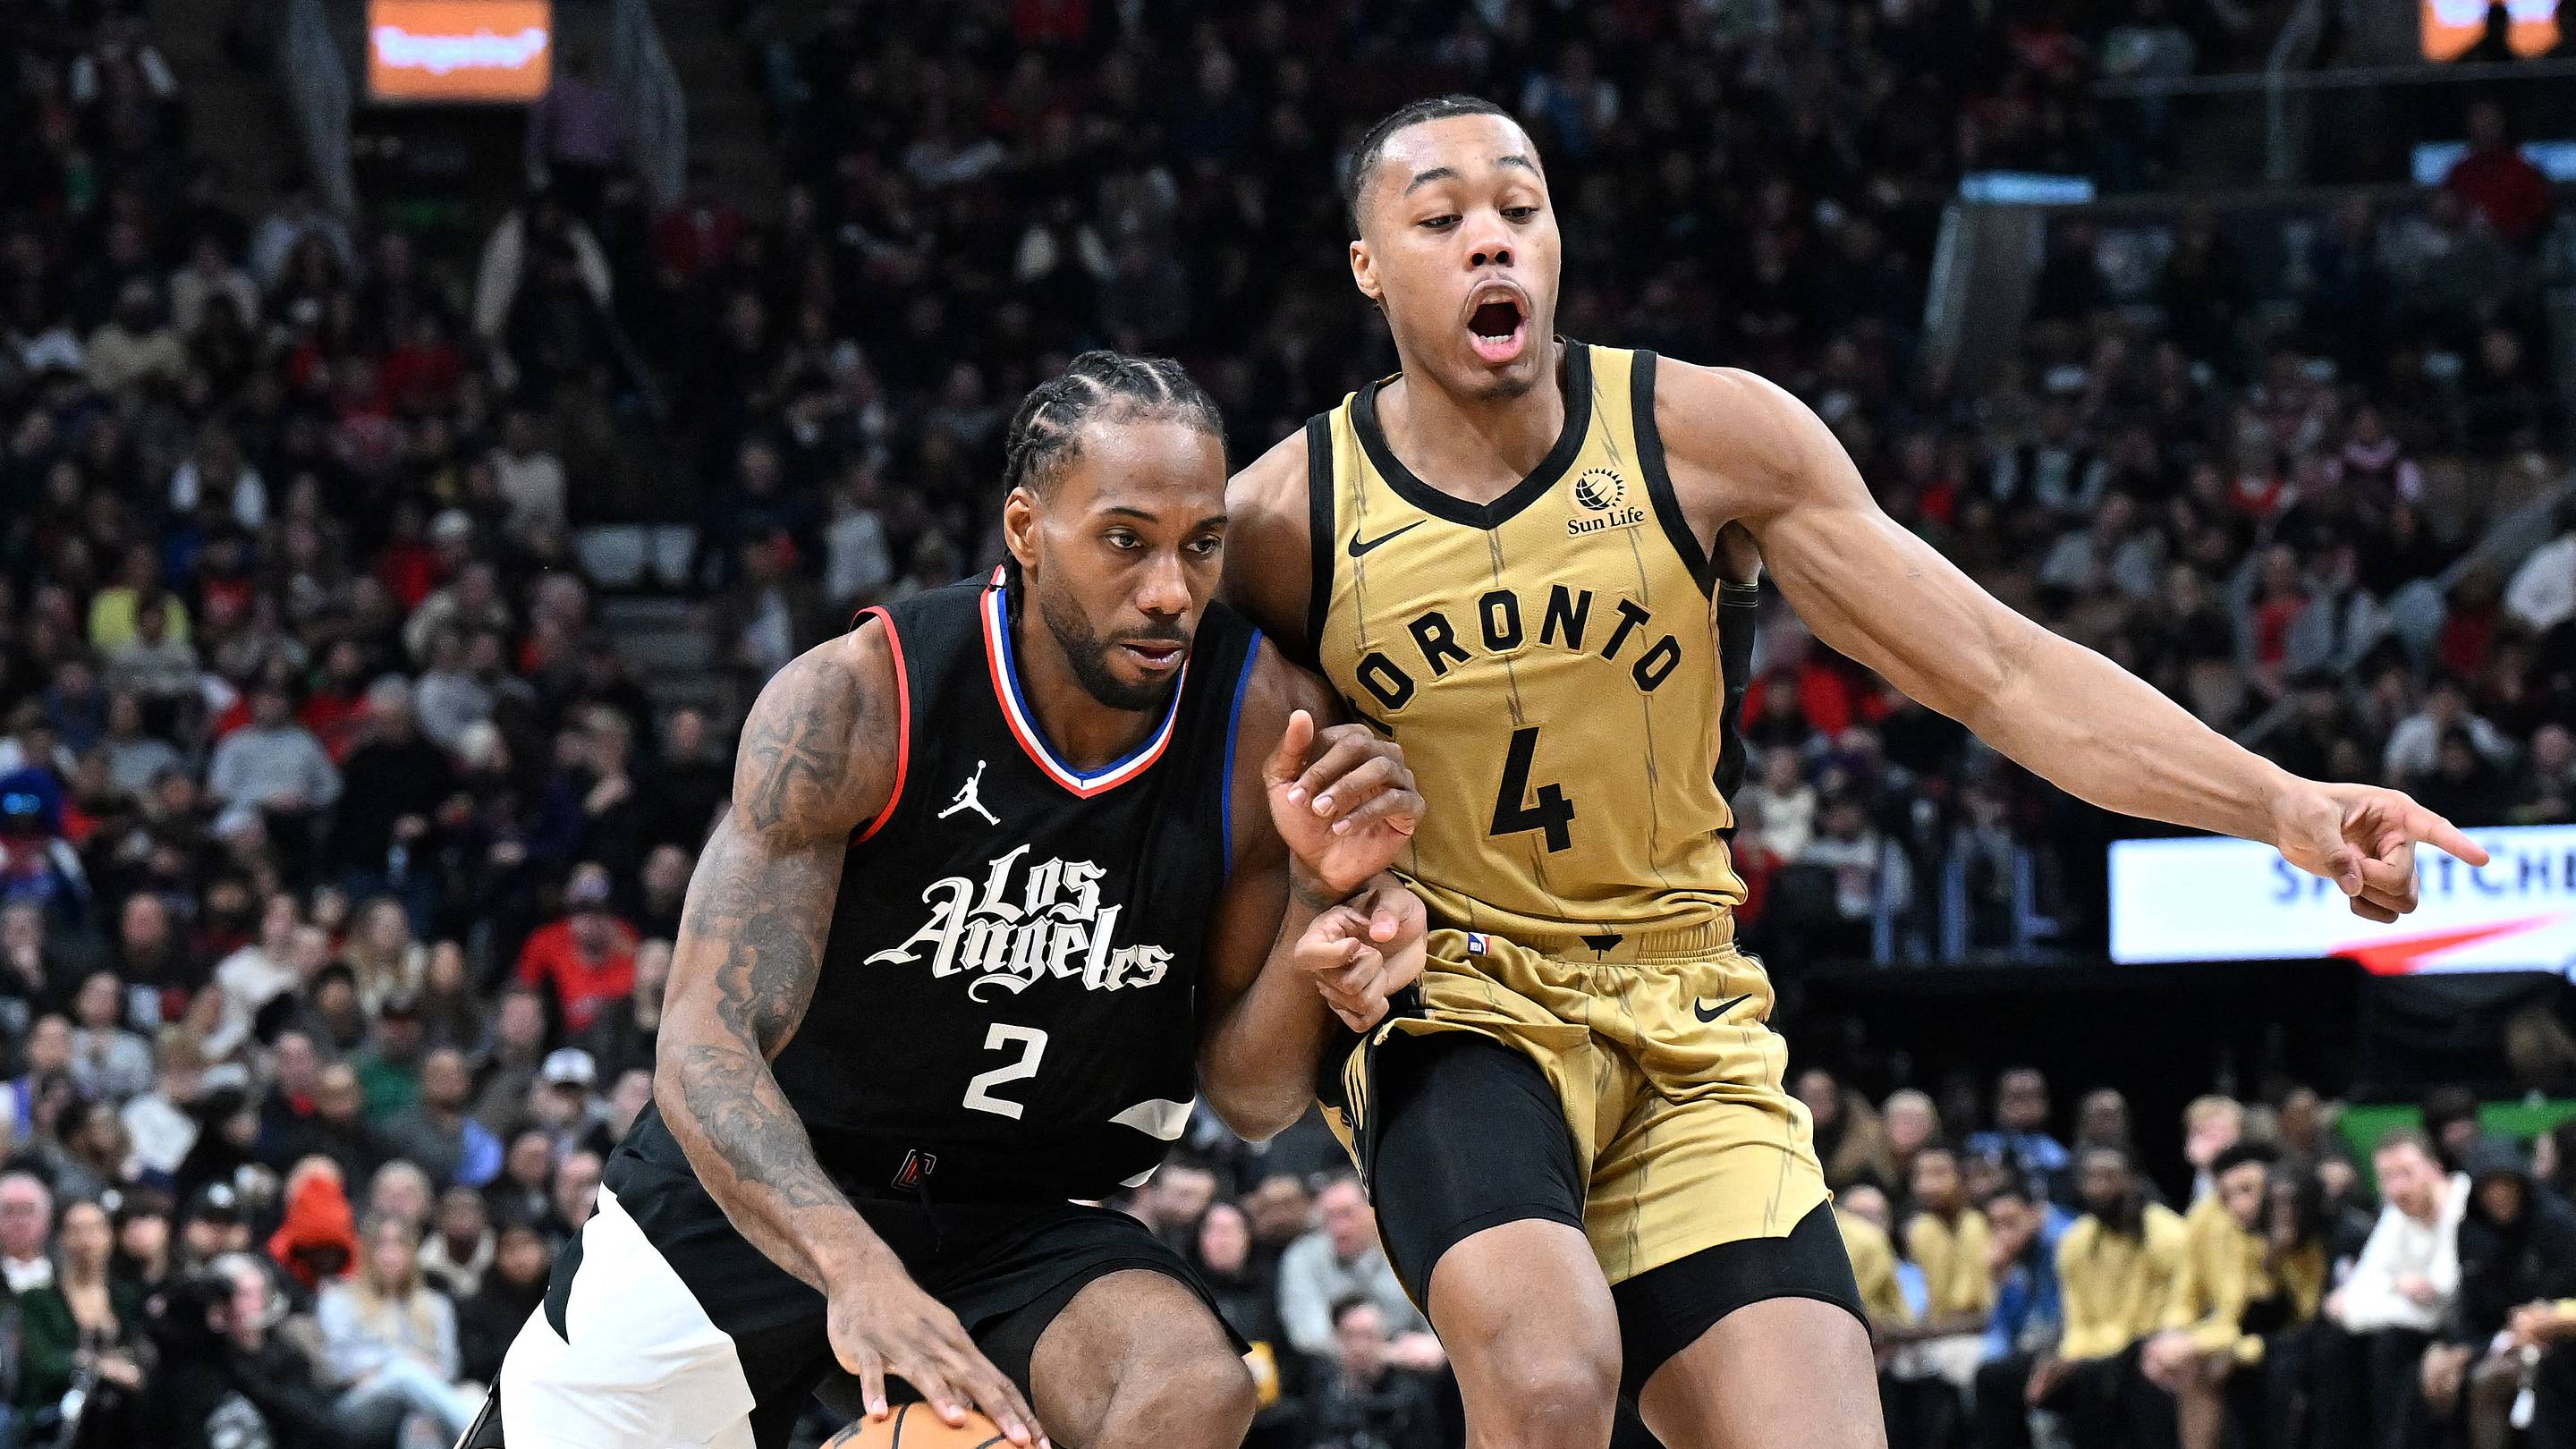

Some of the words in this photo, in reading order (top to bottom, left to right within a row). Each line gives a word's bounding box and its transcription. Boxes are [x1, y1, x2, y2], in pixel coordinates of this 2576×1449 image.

[1568, 518, 1606, 535] Sun
[1608, 506, 1645, 527] Life
[1489, 726, 1575, 853] 4
[968, 843, 1107, 922] Los
[863, 877, 1174, 1003] Angeles
[962, 1022, 1048, 1121] 2
